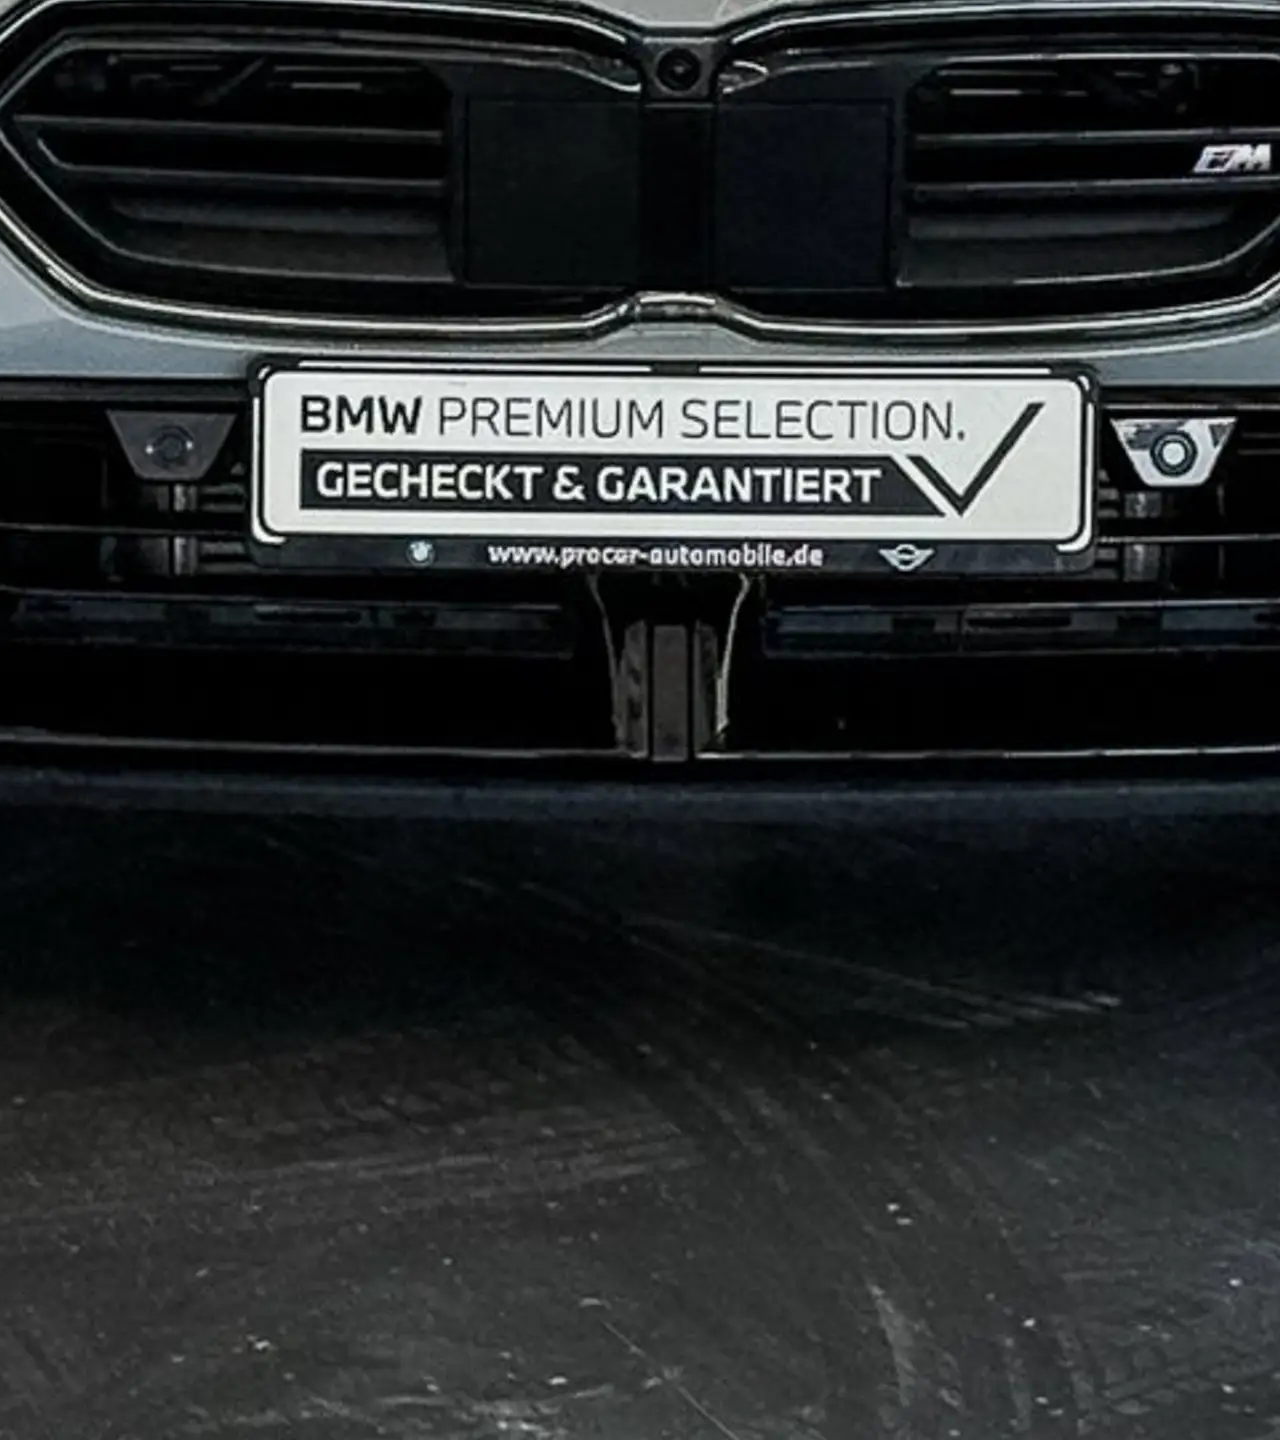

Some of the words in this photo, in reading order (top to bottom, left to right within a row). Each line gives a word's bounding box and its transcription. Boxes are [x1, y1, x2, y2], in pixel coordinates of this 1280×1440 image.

[300, 394, 423, 435] BMW
[439, 396, 664, 439] PREMIUM
[681, 399, 966, 441] SELECTION.
[317, 461, 544, 500] GECHECKT
[553, 465, 585, 501] &
[597, 466, 882, 503] GARANTIERT
[486, 542, 825, 569] www.procar-automobile.de
